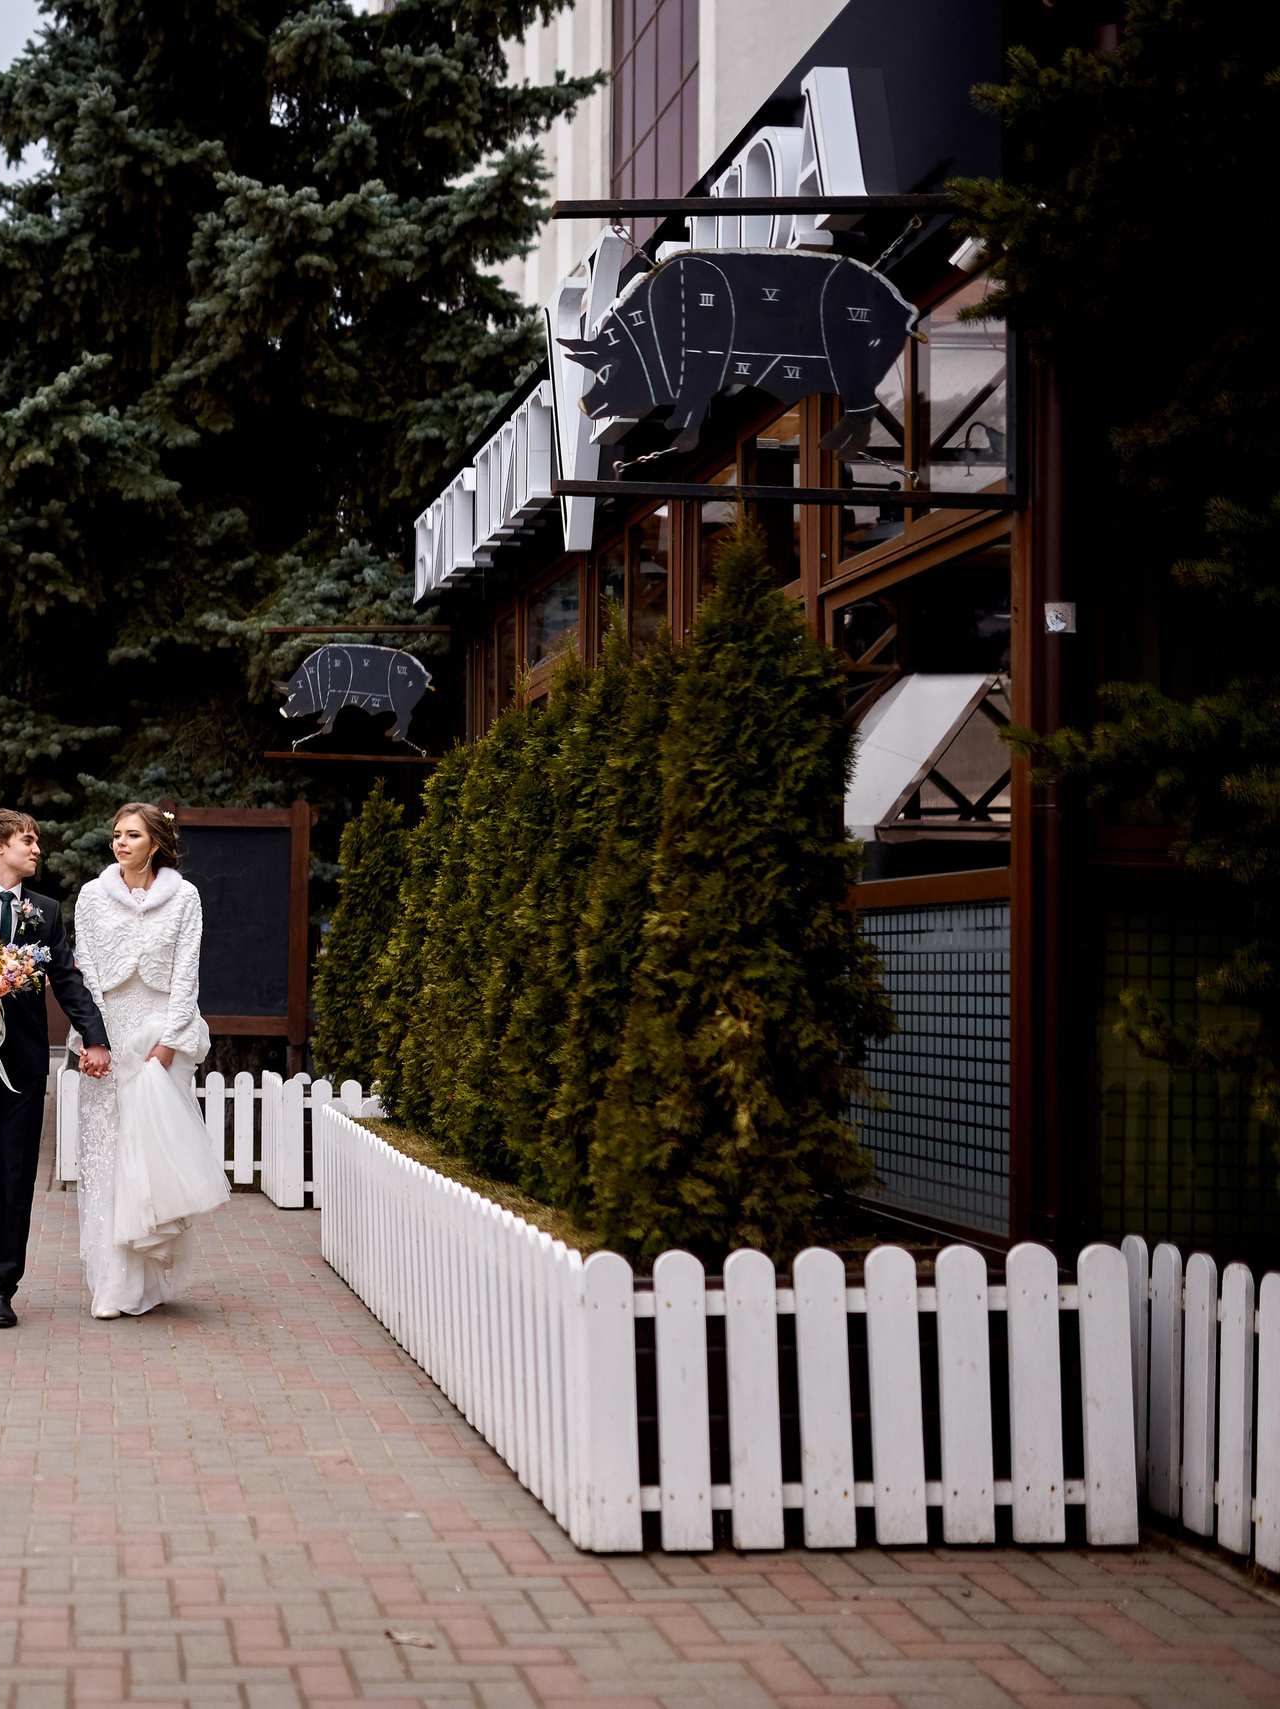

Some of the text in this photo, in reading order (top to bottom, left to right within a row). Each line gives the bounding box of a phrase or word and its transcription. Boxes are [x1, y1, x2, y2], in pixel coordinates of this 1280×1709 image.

[698, 292, 716, 307] III
[761, 287, 781, 302] V
[627, 309, 646, 327] II
[846, 306, 872, 323] VII
[602, 327, 621, 347] I
[734, 361, 752, 375] IV
[782, 365, 802, 379] VI
